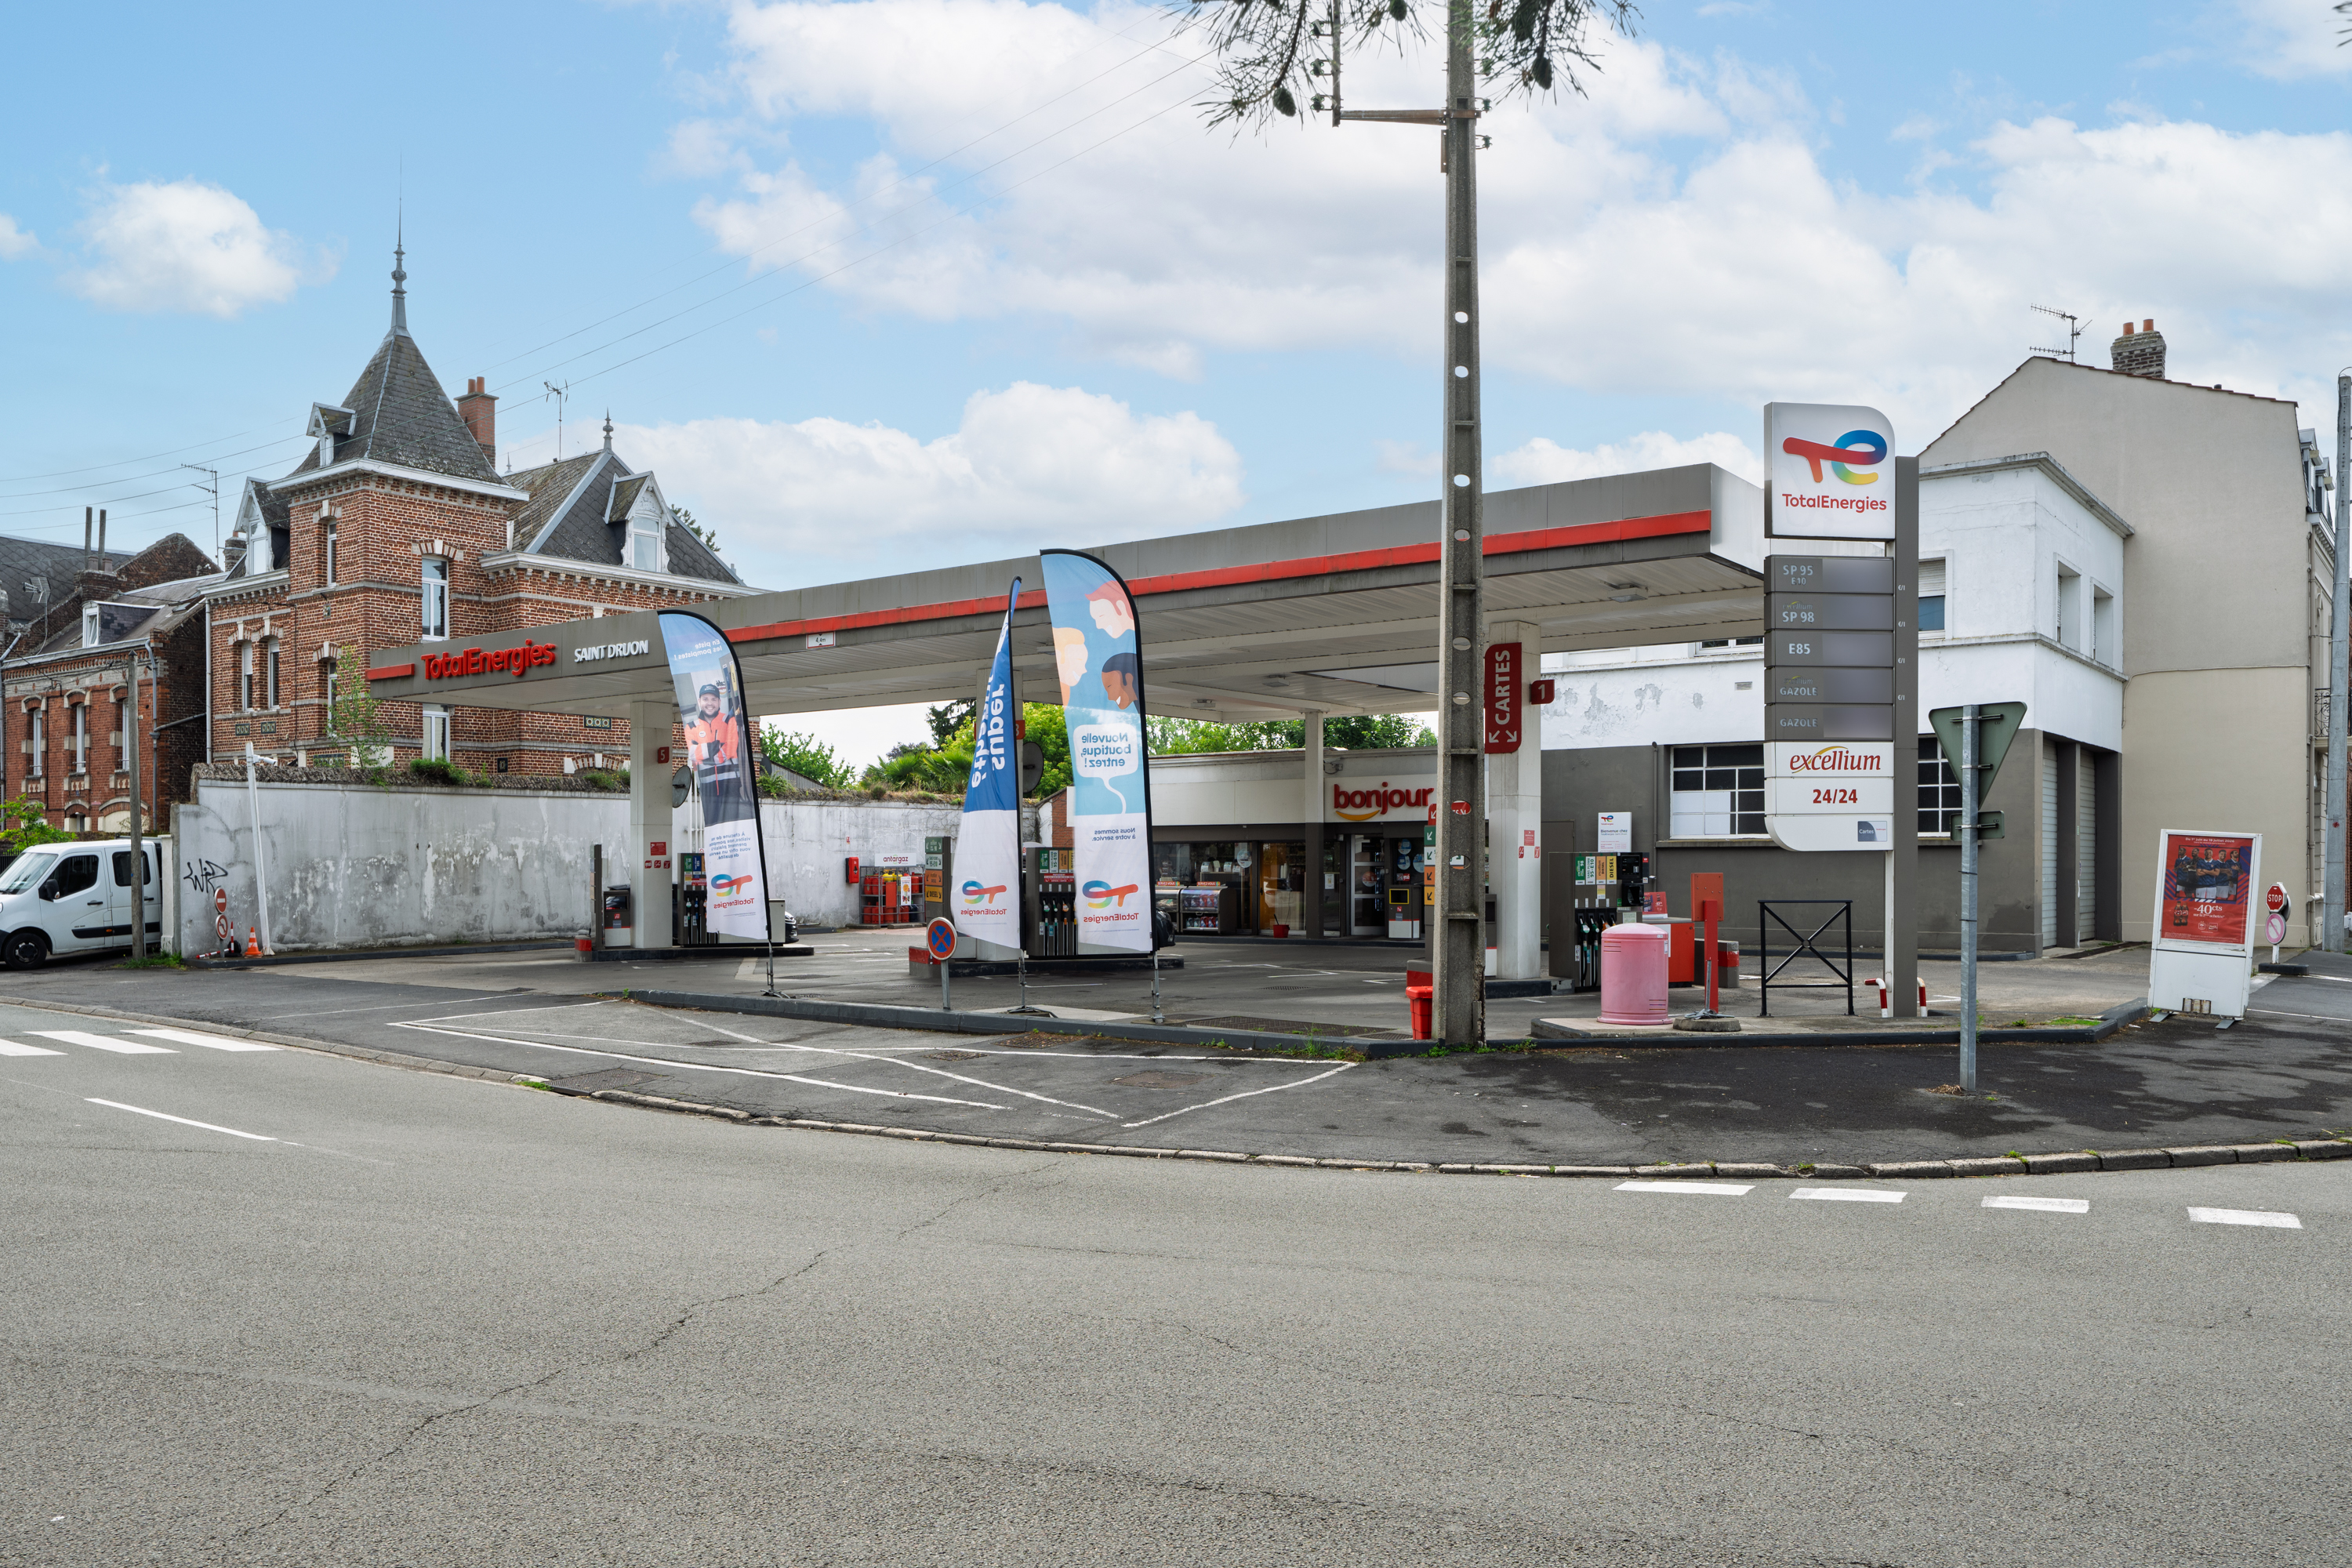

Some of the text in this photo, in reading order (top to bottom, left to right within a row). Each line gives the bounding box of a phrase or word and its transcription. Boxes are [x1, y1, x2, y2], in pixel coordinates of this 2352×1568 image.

[1782, 493, 1887, 514] TotalEnergies
[1783, 564, 1813, 575] SP 95
[1783, 601, 1813, 610] excellium
[1782, 612, 1815, 623] SP 98
[574, 639, 649, 663] SAINT DRUON
[1788, 644, 1811, 655] E85
[421, 639, 556, 680] TotalEnergies
[1495, 650, 1511, 725] CARTES
[1537, 684, 1545, 700] 1
[1780, 687, 1817, 696] GAZOLE
[1780, 718, 1818, 728] GAZOLE
[660, 750, 666, 760] 5
[1790, 749, 1881, 771] excellium
[1334, 782, 1435, 815] bonjour
[1813, 789, 1858, 804] 24/24
[884, 855, 908, 864] antargaz
